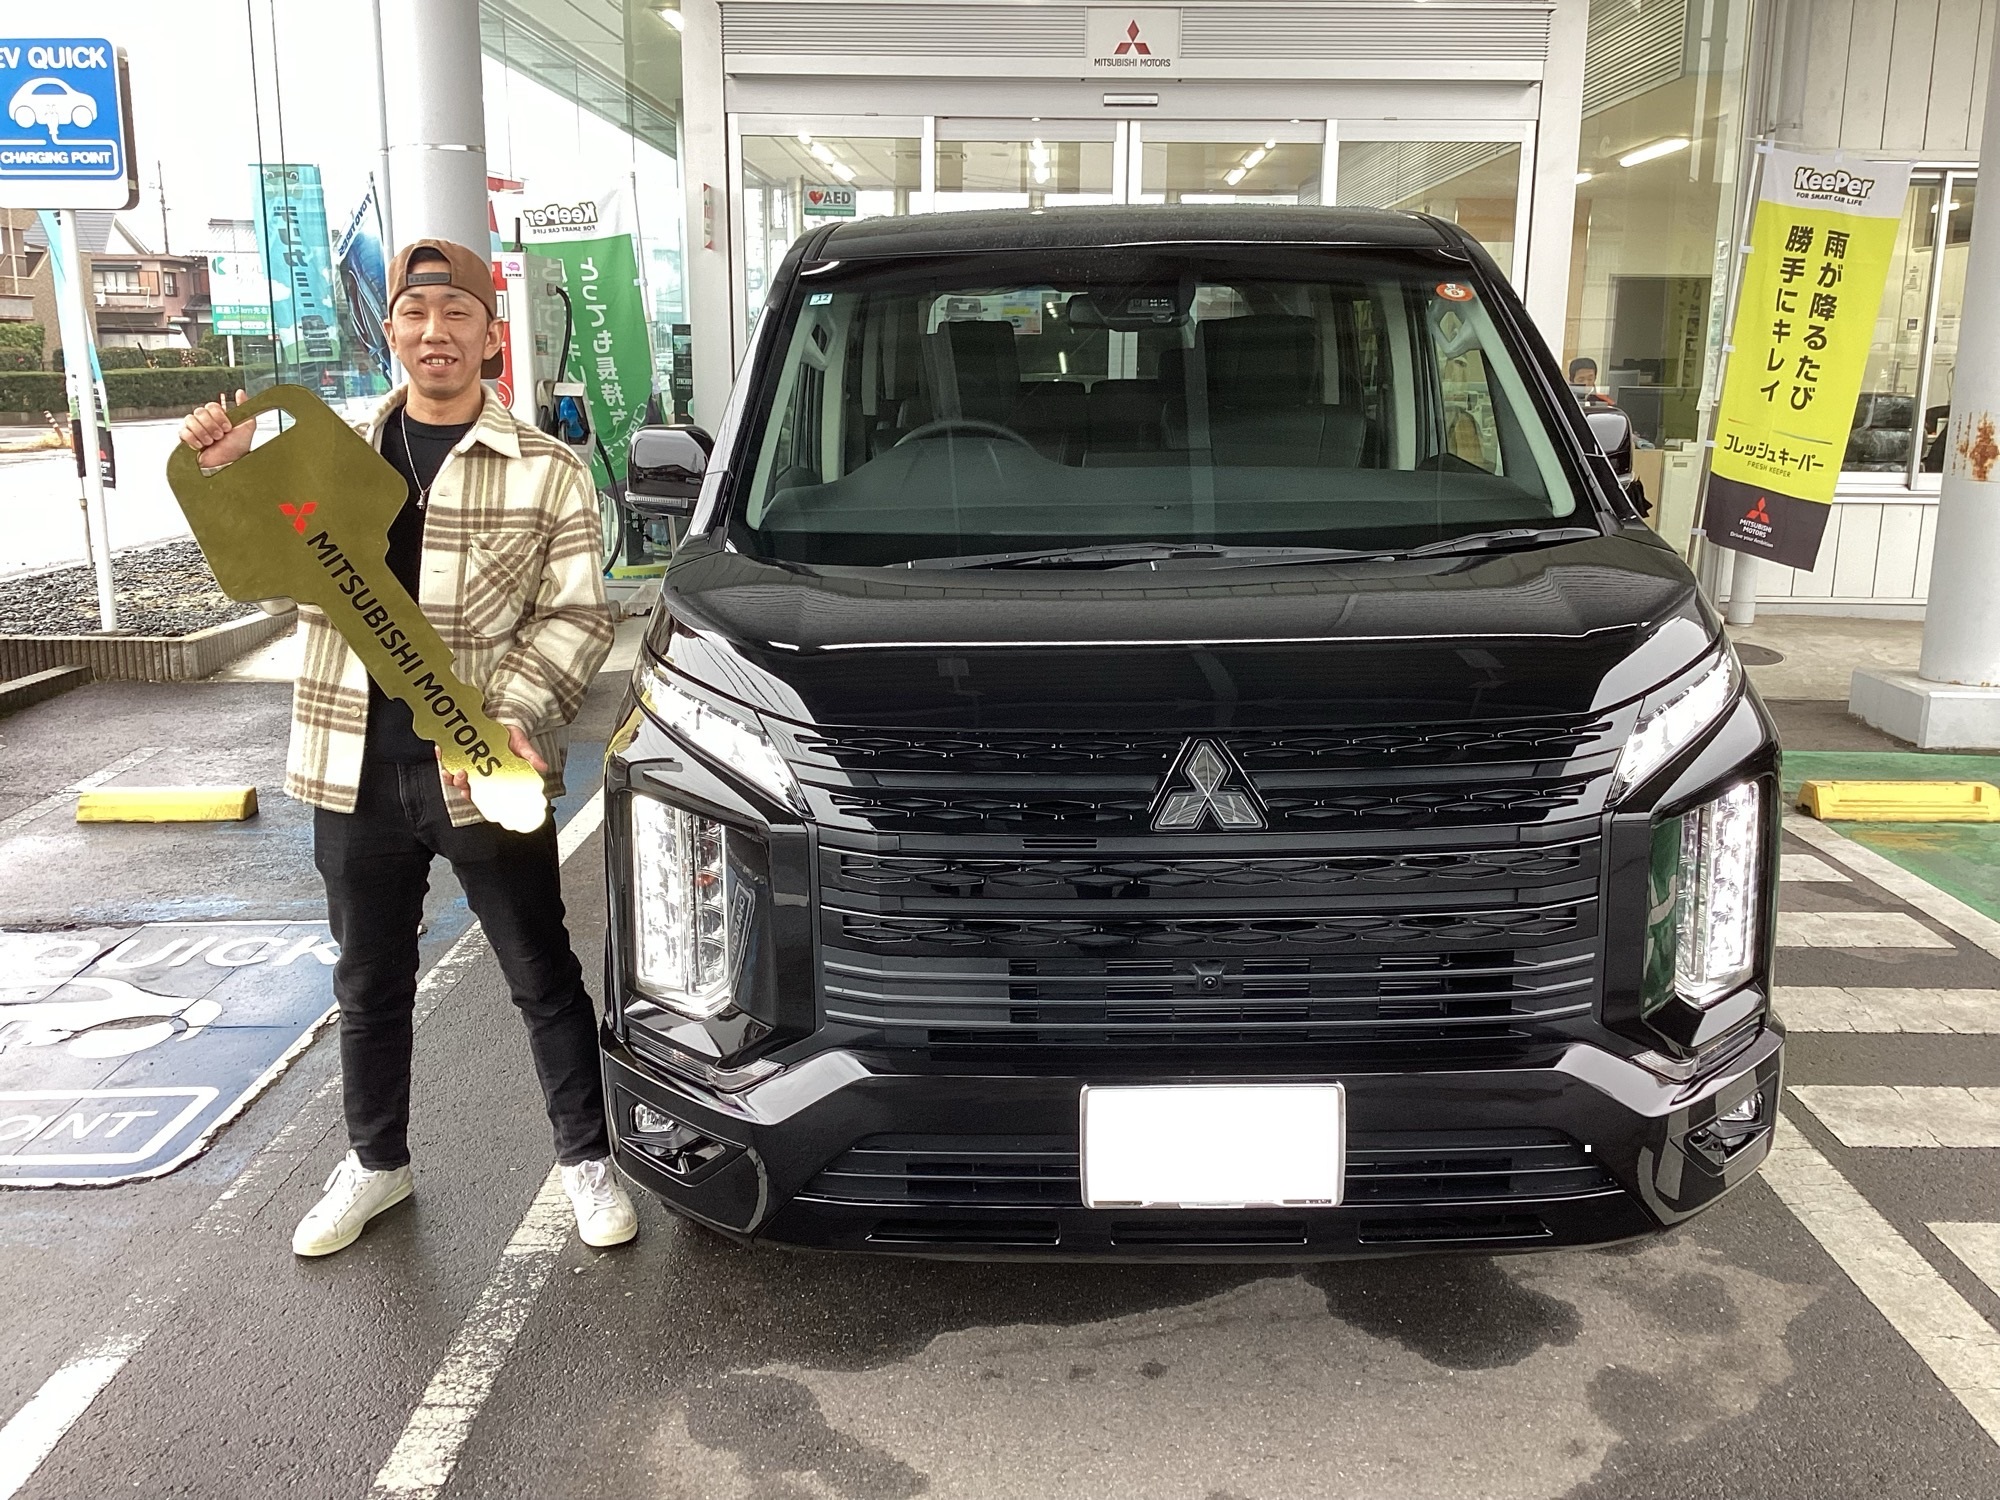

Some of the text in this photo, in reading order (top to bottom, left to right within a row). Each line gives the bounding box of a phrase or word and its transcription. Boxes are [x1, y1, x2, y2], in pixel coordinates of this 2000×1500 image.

[27, 46, 108, 70] QUICK
[1094, 58, 1171, 67] MITSUBISHI MOTORS
[0, 151, 112, 164] CHARGING POINT
[1794, 166, 1875, 199] KeePer
[823, 191, 851, 205] AED
[1811, 193, 1833, 201] SMART
[1834, 195, 1845, 203] CAR
[1846, 198, 1863, 206] LIFE
[1760, 225, 1814, 402] 勝手にキレイ
[1790, 229, 1850, 411] 雨が降るたび
[1724, 434, 1824, 472] フレッシュキーパー
[1746, 460, 1791, 478] FRESH KEEPER
[1739, 518, 1773, 533] MITSUBISHI
[1742, 526, 1767, 538] MOTORS
[307, 531, 502, 777] MITSUBISHI MOTORS
